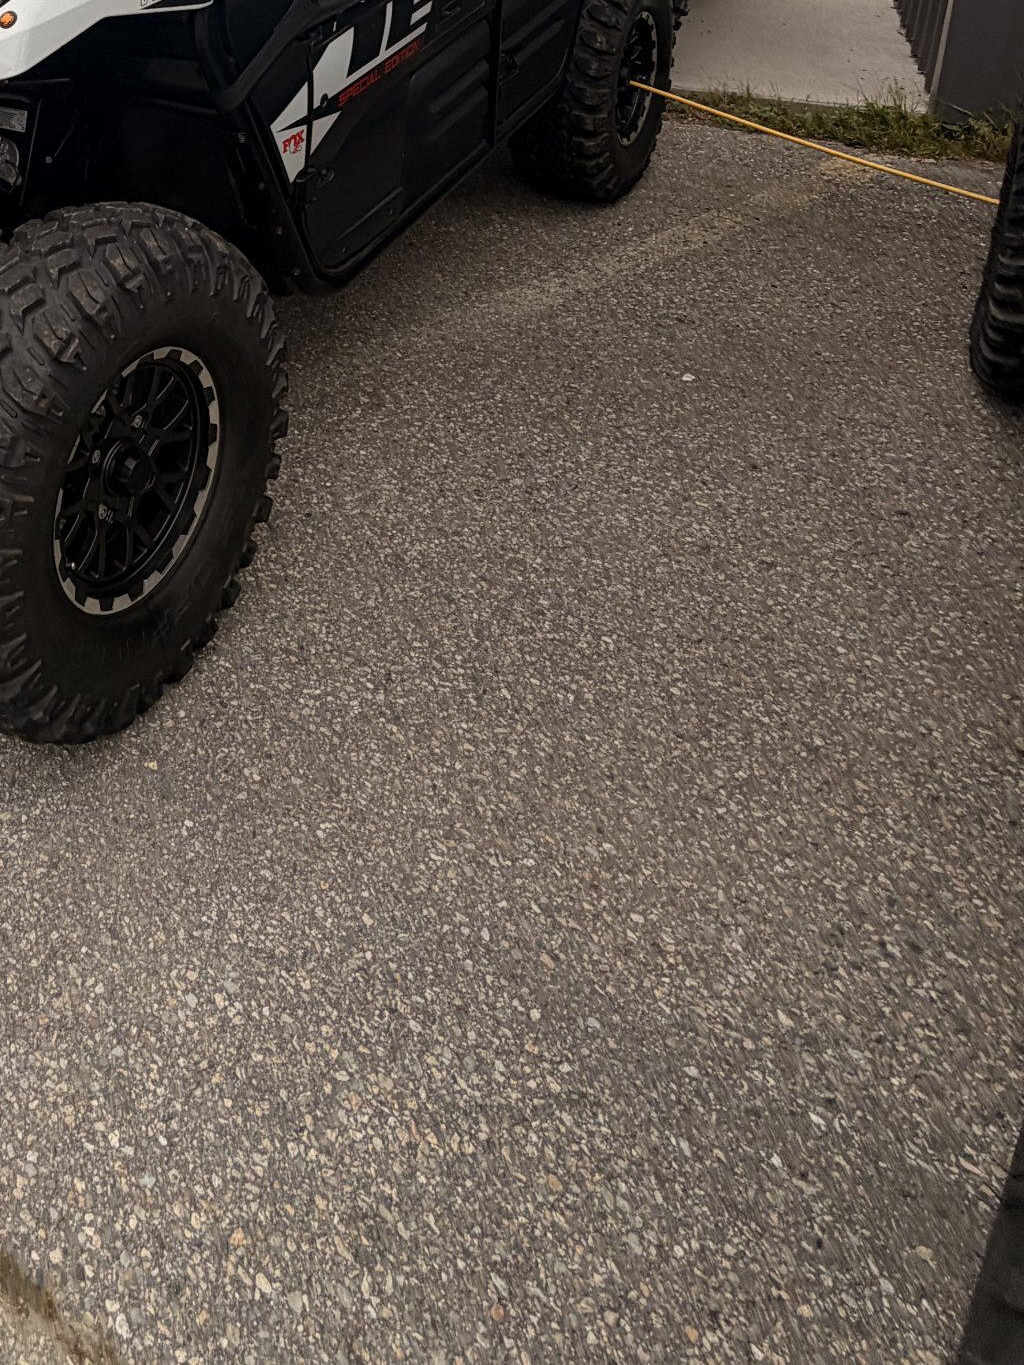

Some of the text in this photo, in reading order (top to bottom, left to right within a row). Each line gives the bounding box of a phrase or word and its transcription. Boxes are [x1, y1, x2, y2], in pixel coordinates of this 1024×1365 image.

[337, 39, 420, 108] SPECIAL EDITION
[282, 129, 305, 155] FOX
